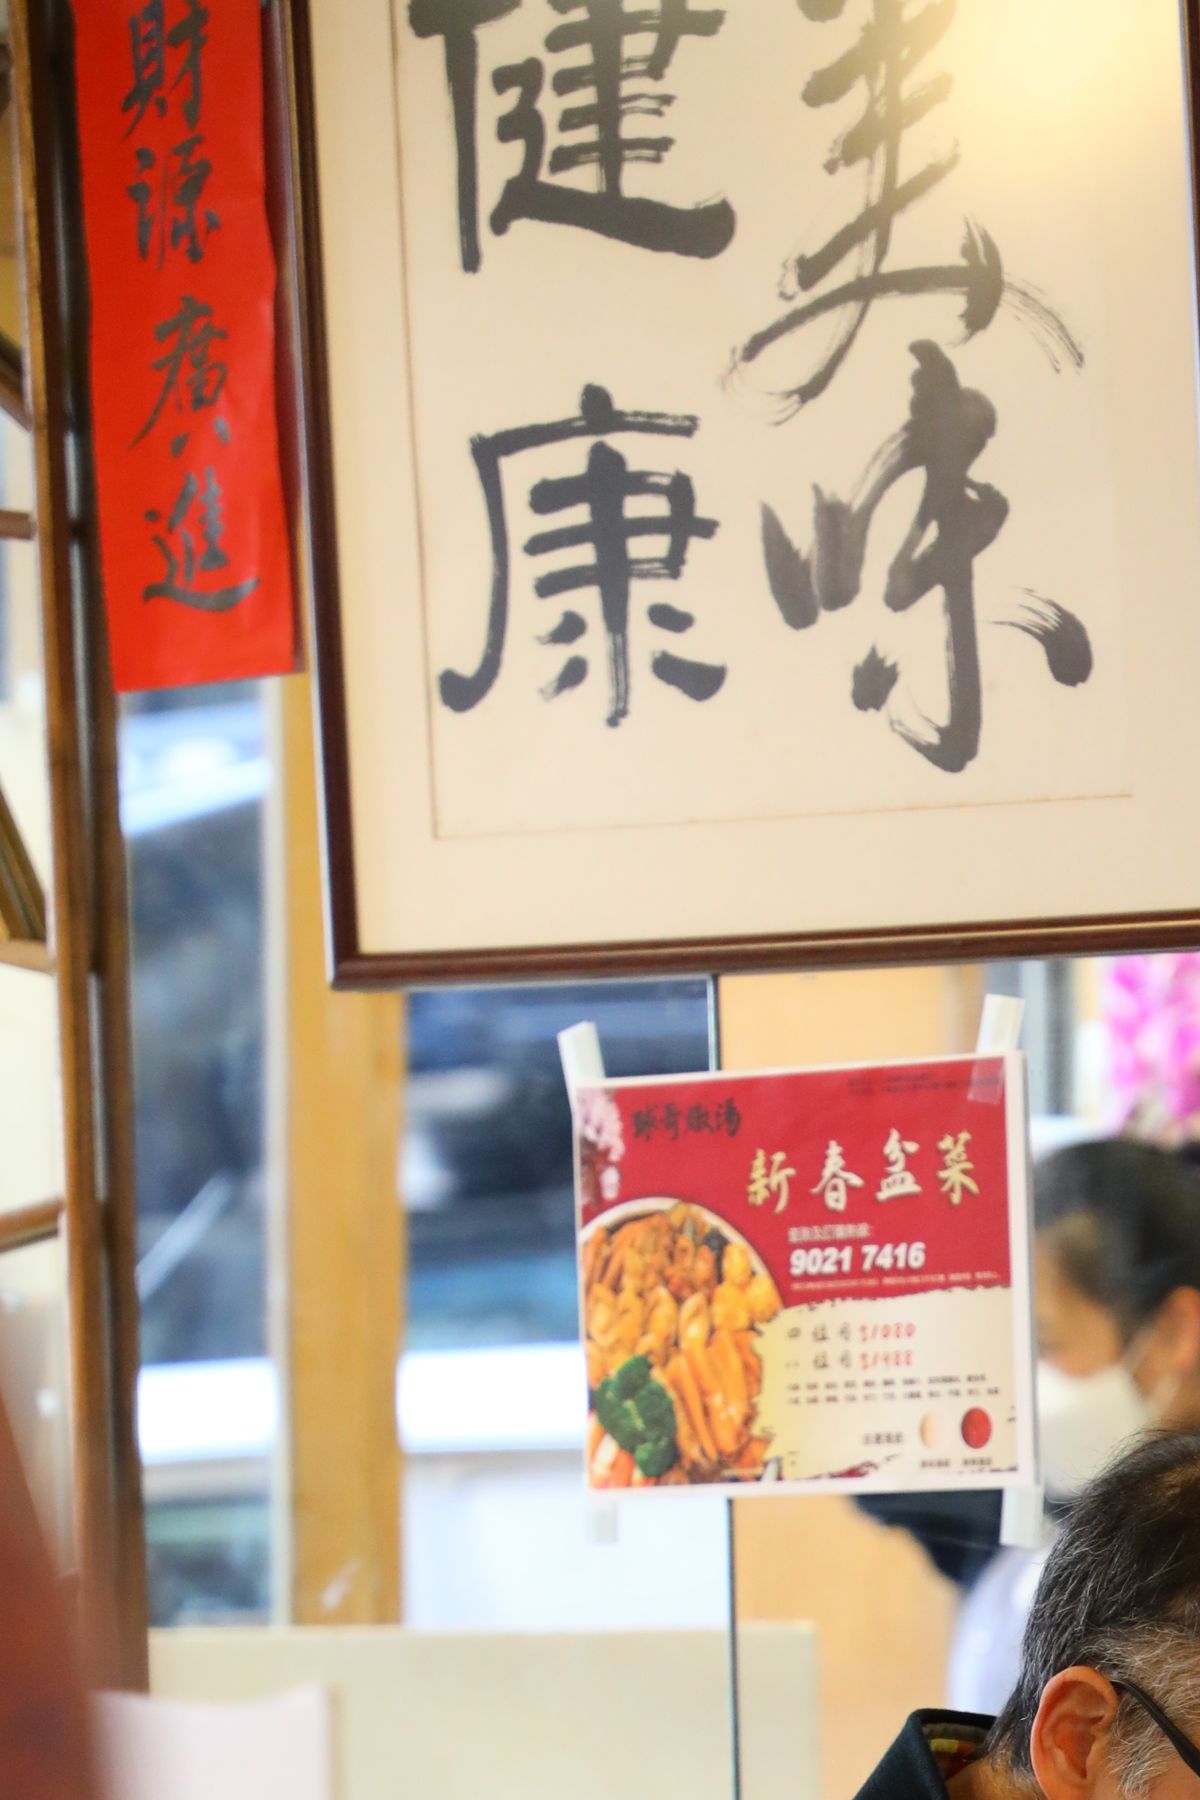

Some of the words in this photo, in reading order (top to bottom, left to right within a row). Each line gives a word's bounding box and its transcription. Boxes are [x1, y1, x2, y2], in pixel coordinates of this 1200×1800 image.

[747, 1127, 981, 1213] 新春盆菜
[789, 1245, 852, 1276] 9021
[861, 1241, 927, 1271] 7416
